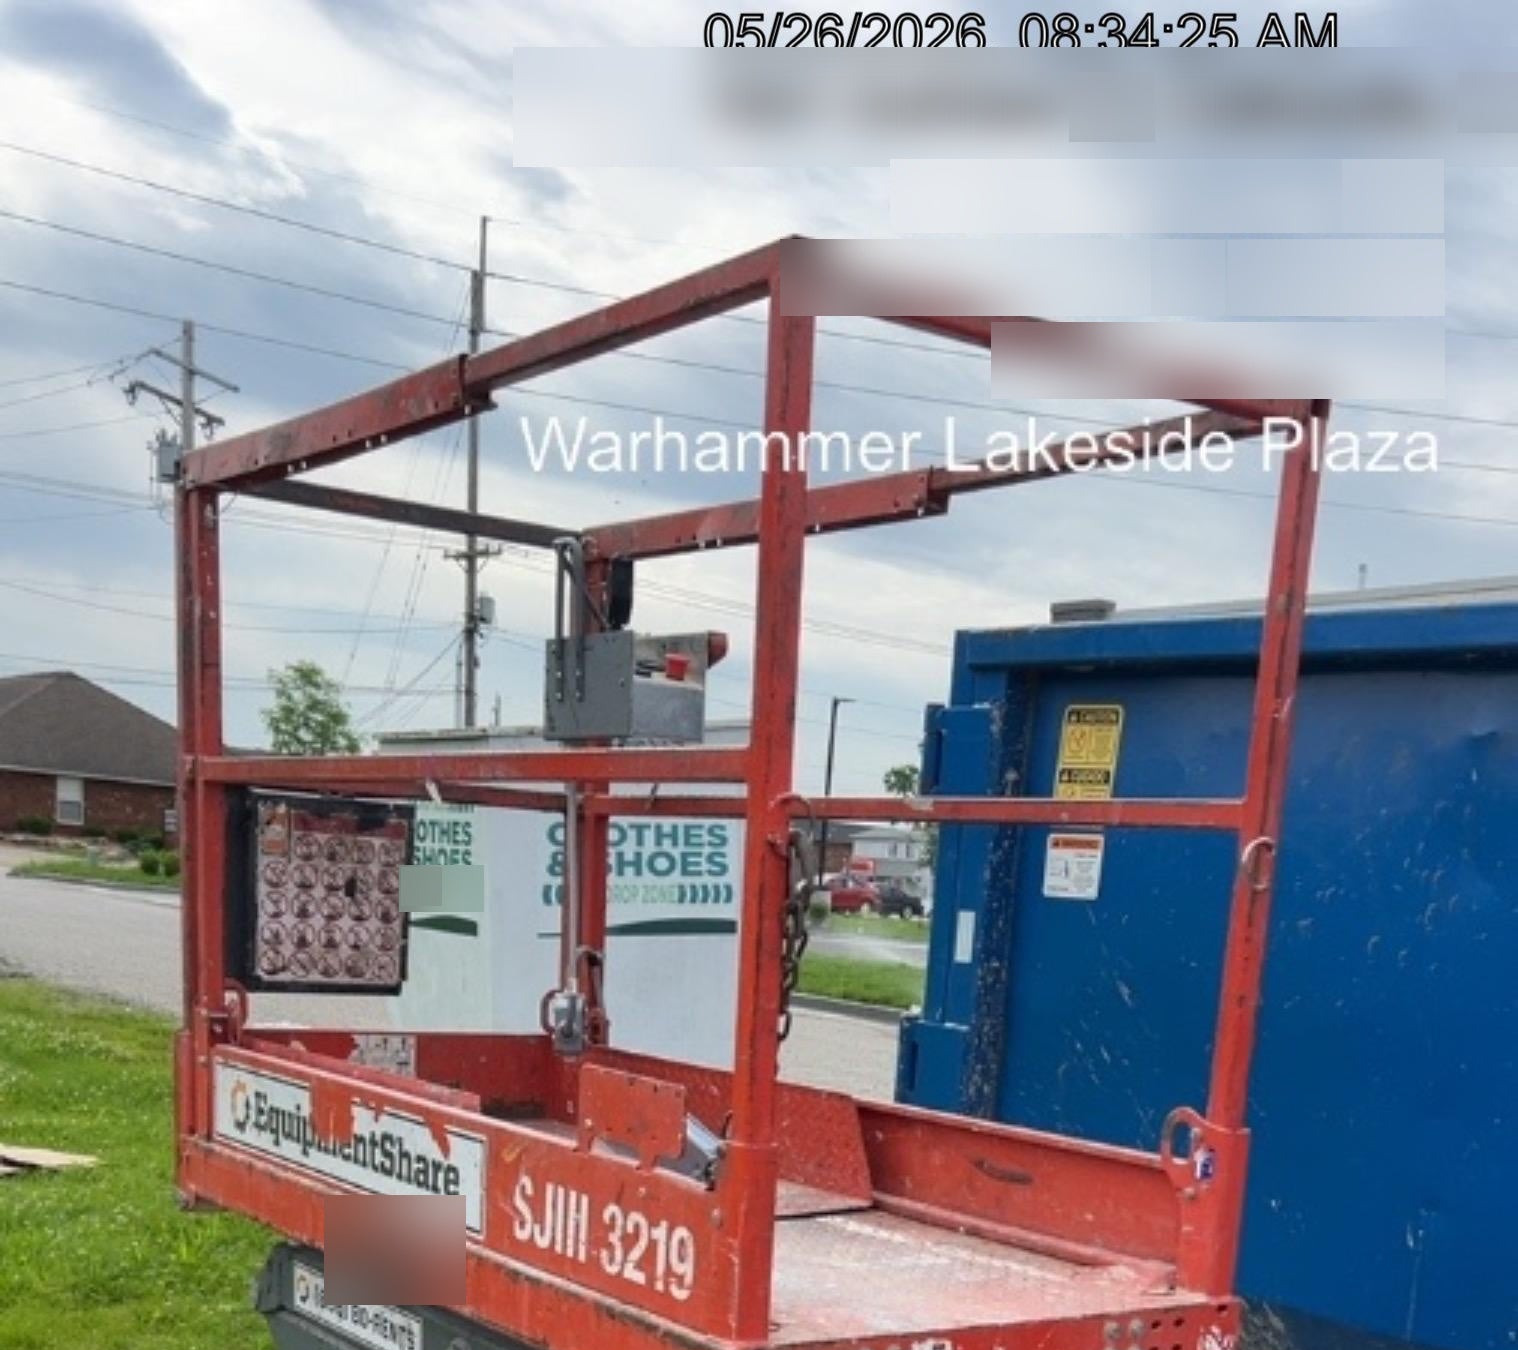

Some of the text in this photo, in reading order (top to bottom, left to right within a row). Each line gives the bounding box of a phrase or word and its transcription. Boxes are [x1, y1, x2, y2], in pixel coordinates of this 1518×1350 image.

[416, 819, 472, 846] OTHES
[546, 822, 728, 848] COTHES
[253, 1090, 461, 1196] EquipentShare
[600, 1202, 695, 1300] 3219
